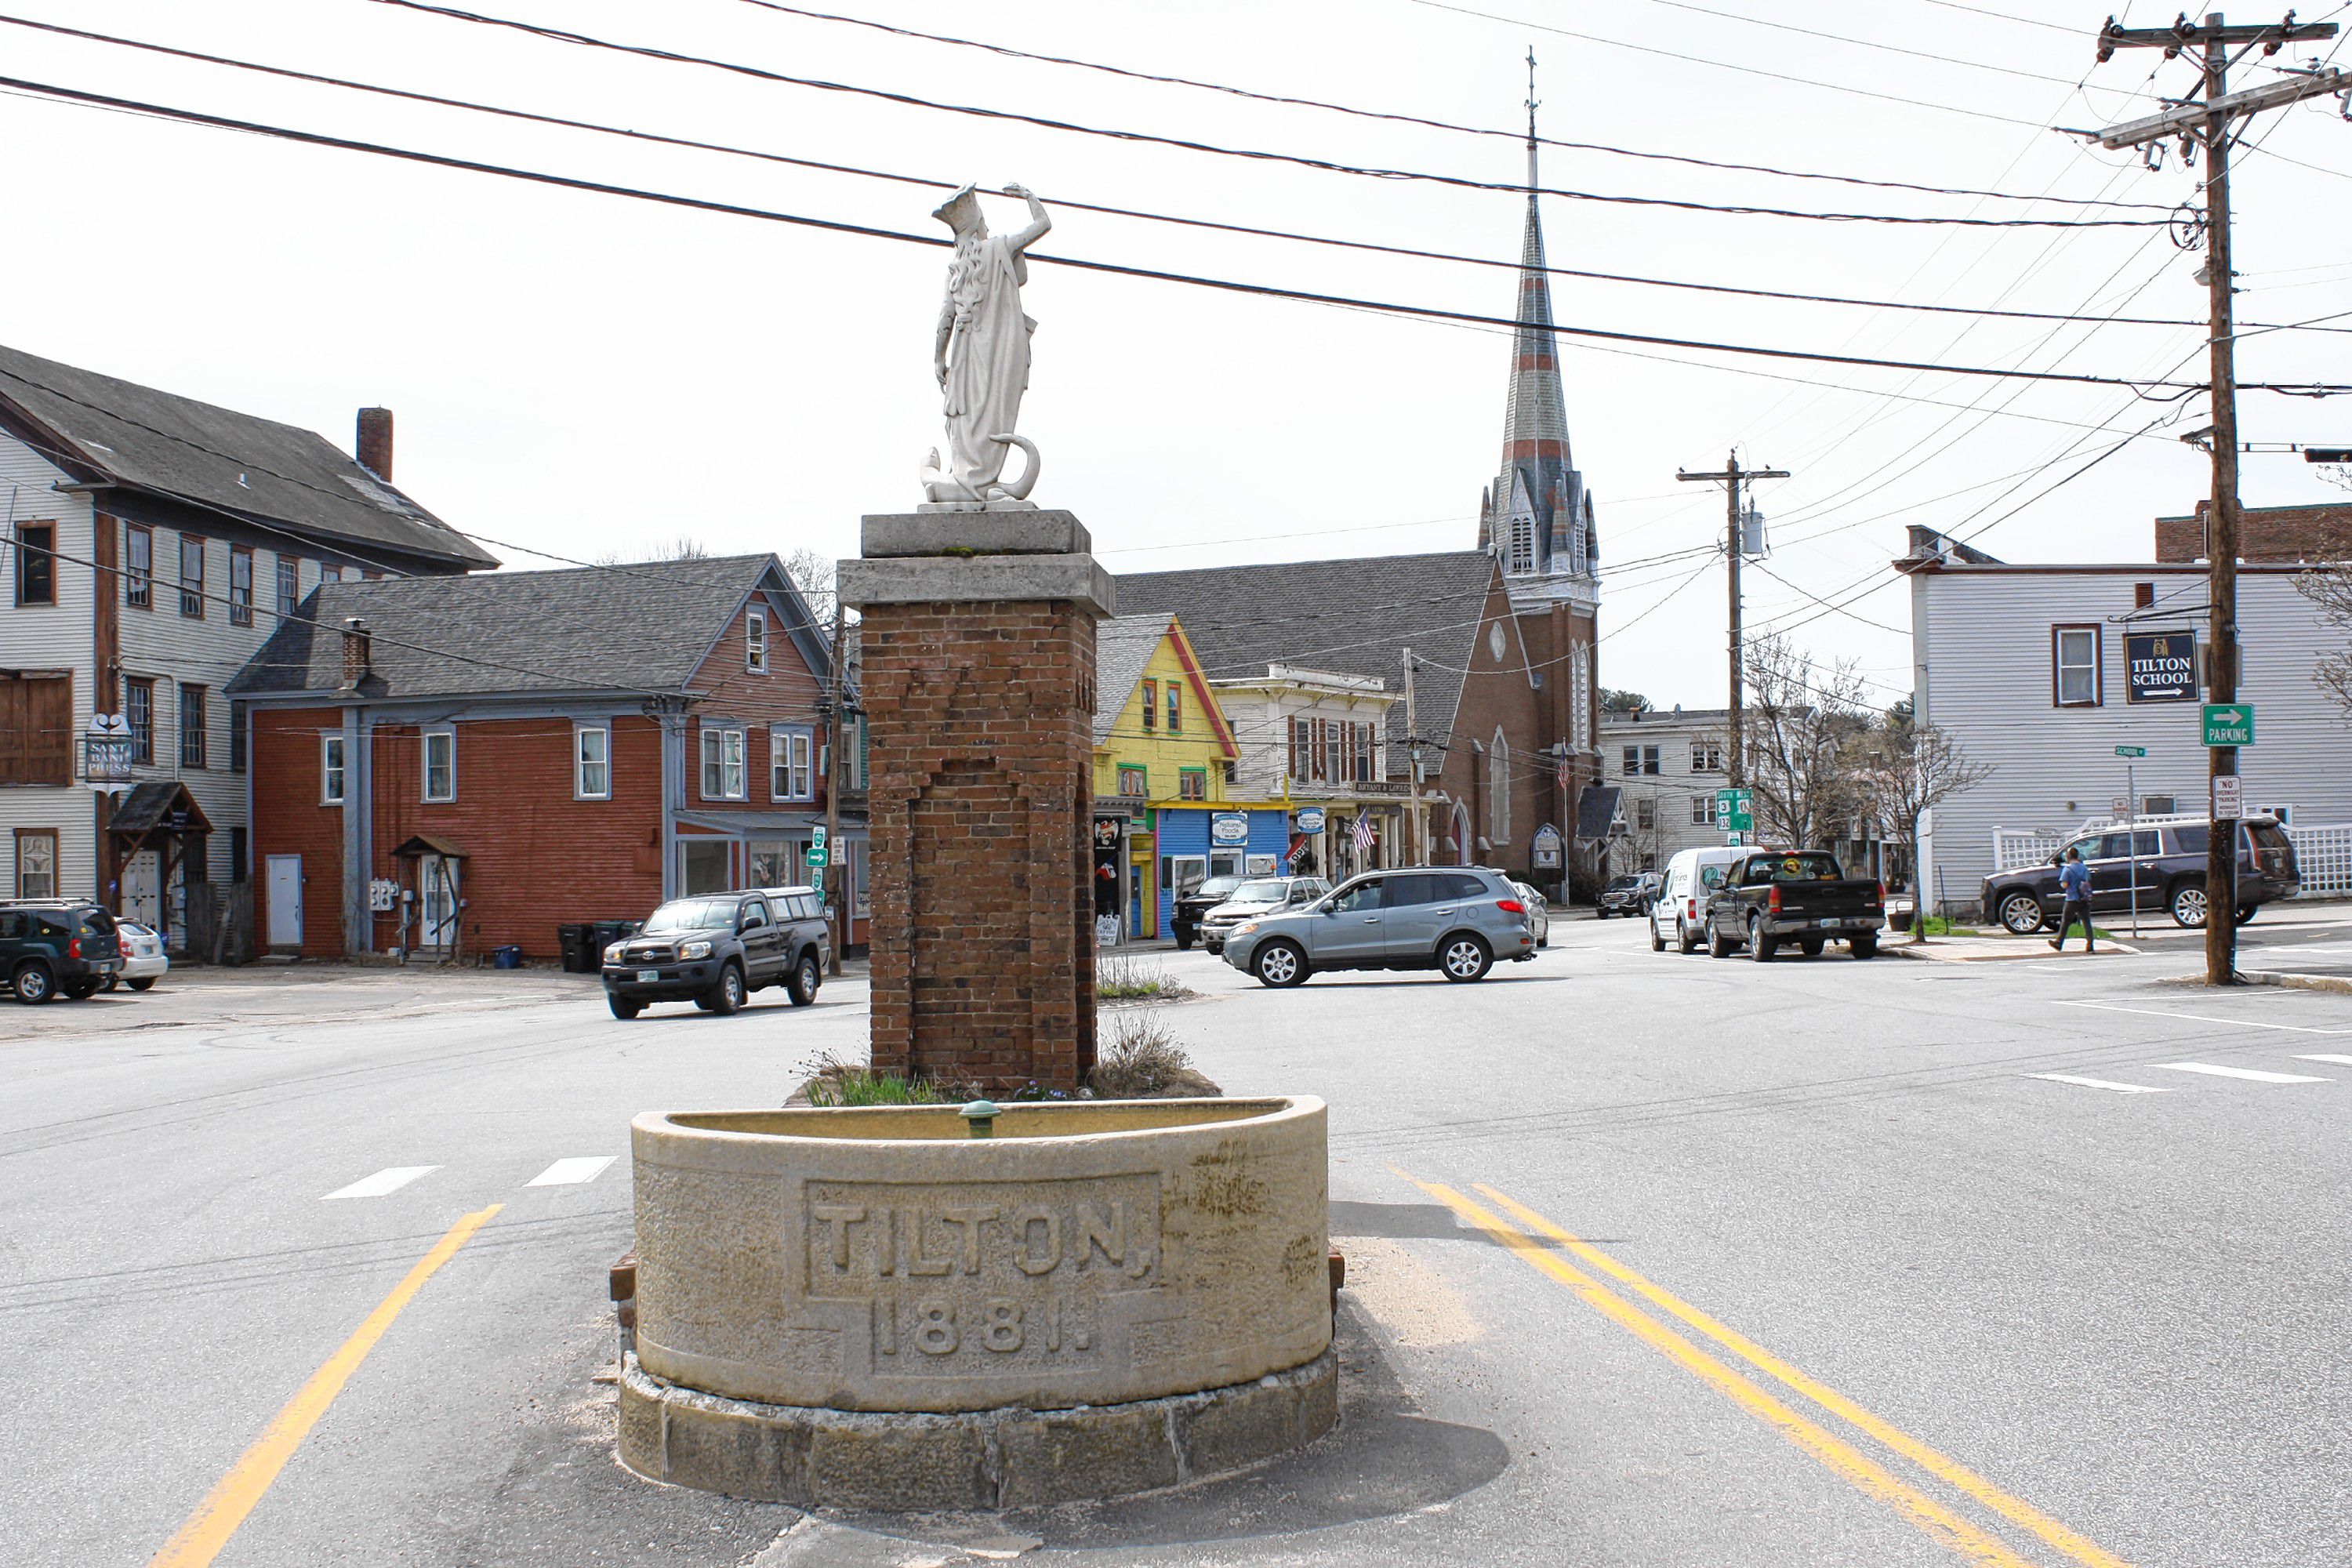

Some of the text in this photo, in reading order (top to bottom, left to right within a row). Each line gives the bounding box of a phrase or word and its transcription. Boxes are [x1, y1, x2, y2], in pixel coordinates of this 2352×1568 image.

[2131, 657, 2191, 673] TILTON
[2132, 672, 2193, 686] SCHOOL
[2209, 728, 2249, 742] PARKING
[90, 743, 127, 753] SANT
[88, 763, 130, 772] PRESS
[1721, 802, 1727, 811] 3
[1719, 818, 1730, 828] 132
